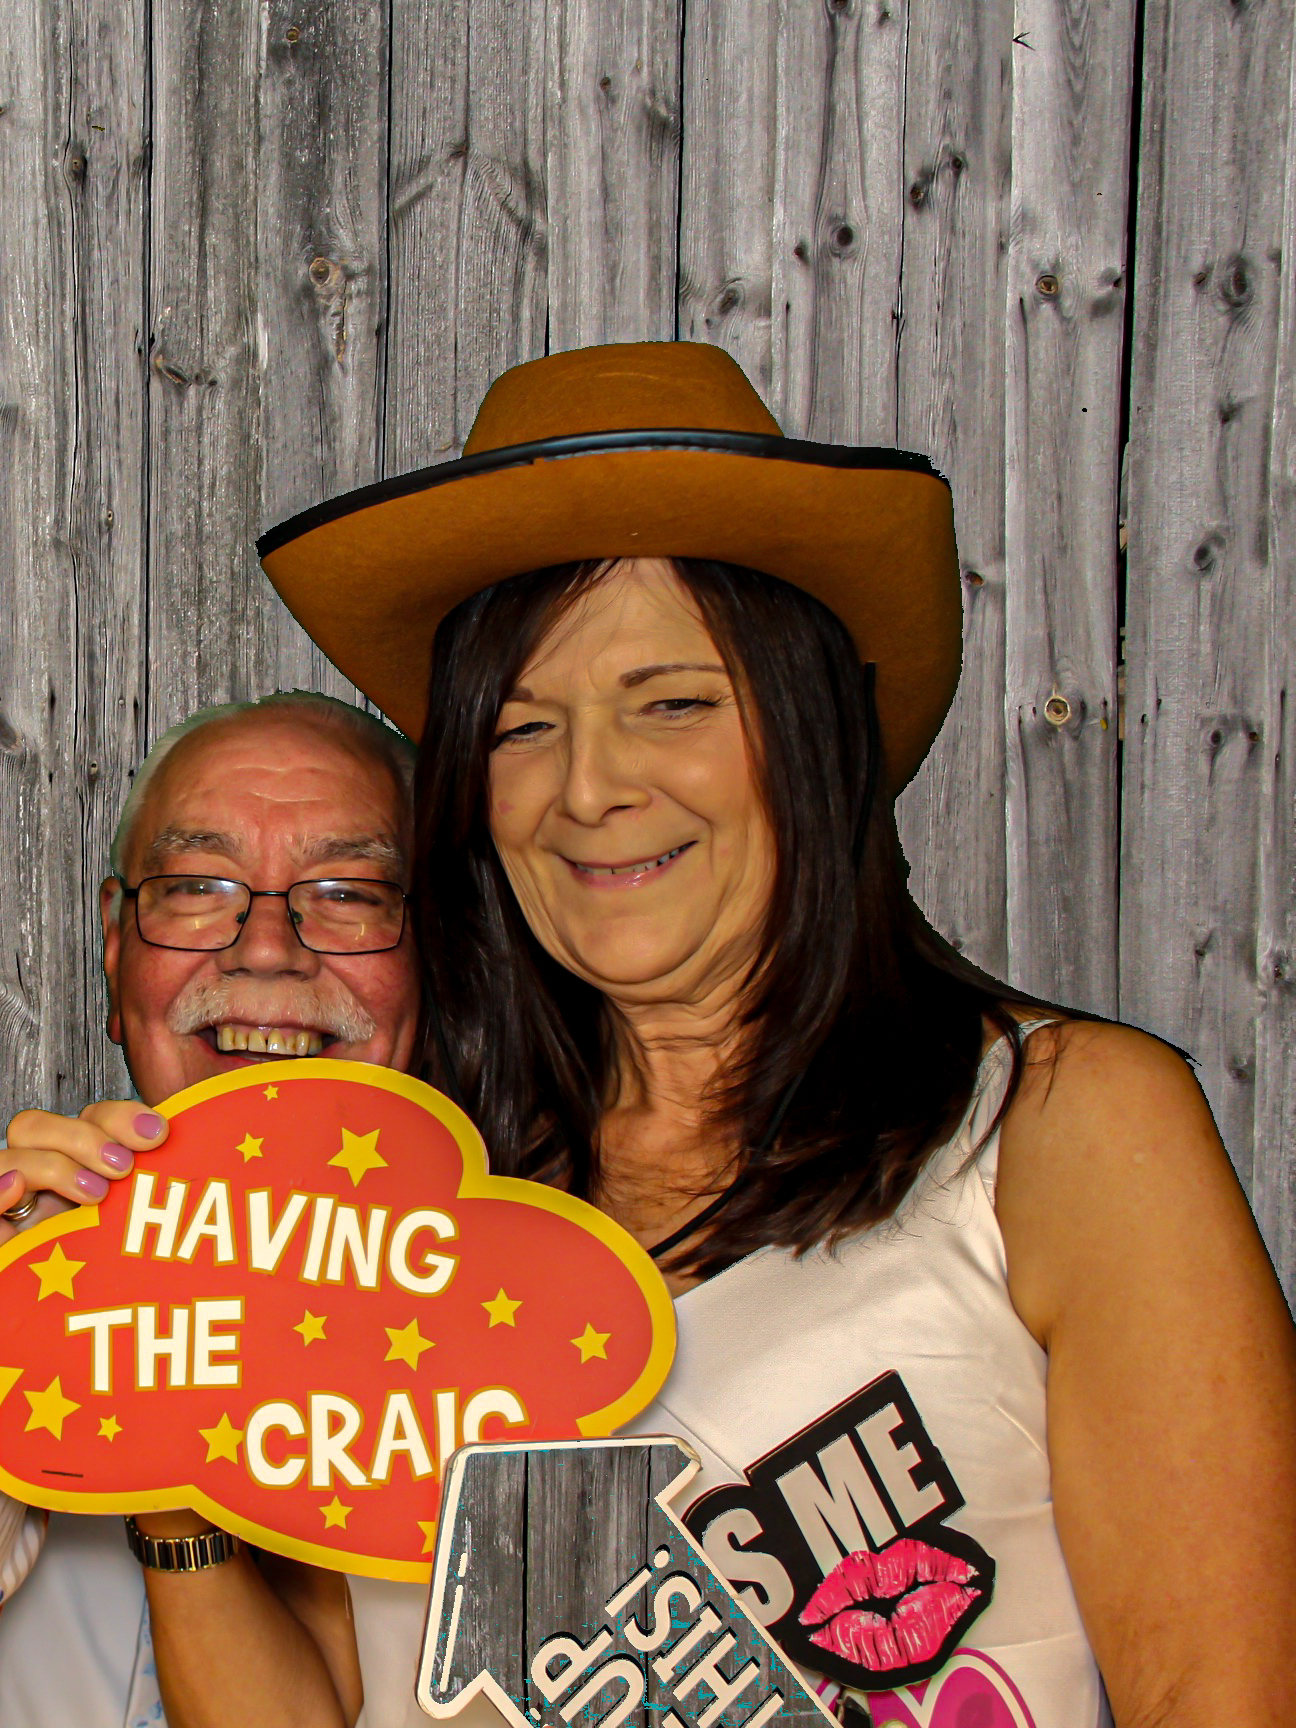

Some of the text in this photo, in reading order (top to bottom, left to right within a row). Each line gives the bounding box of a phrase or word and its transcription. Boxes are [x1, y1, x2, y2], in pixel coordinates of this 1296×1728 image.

[122, 1169, 460, 1298] HAVING
[65, 1296, 245, 1395] THE
[774, 1401, 946, 1581] ME
